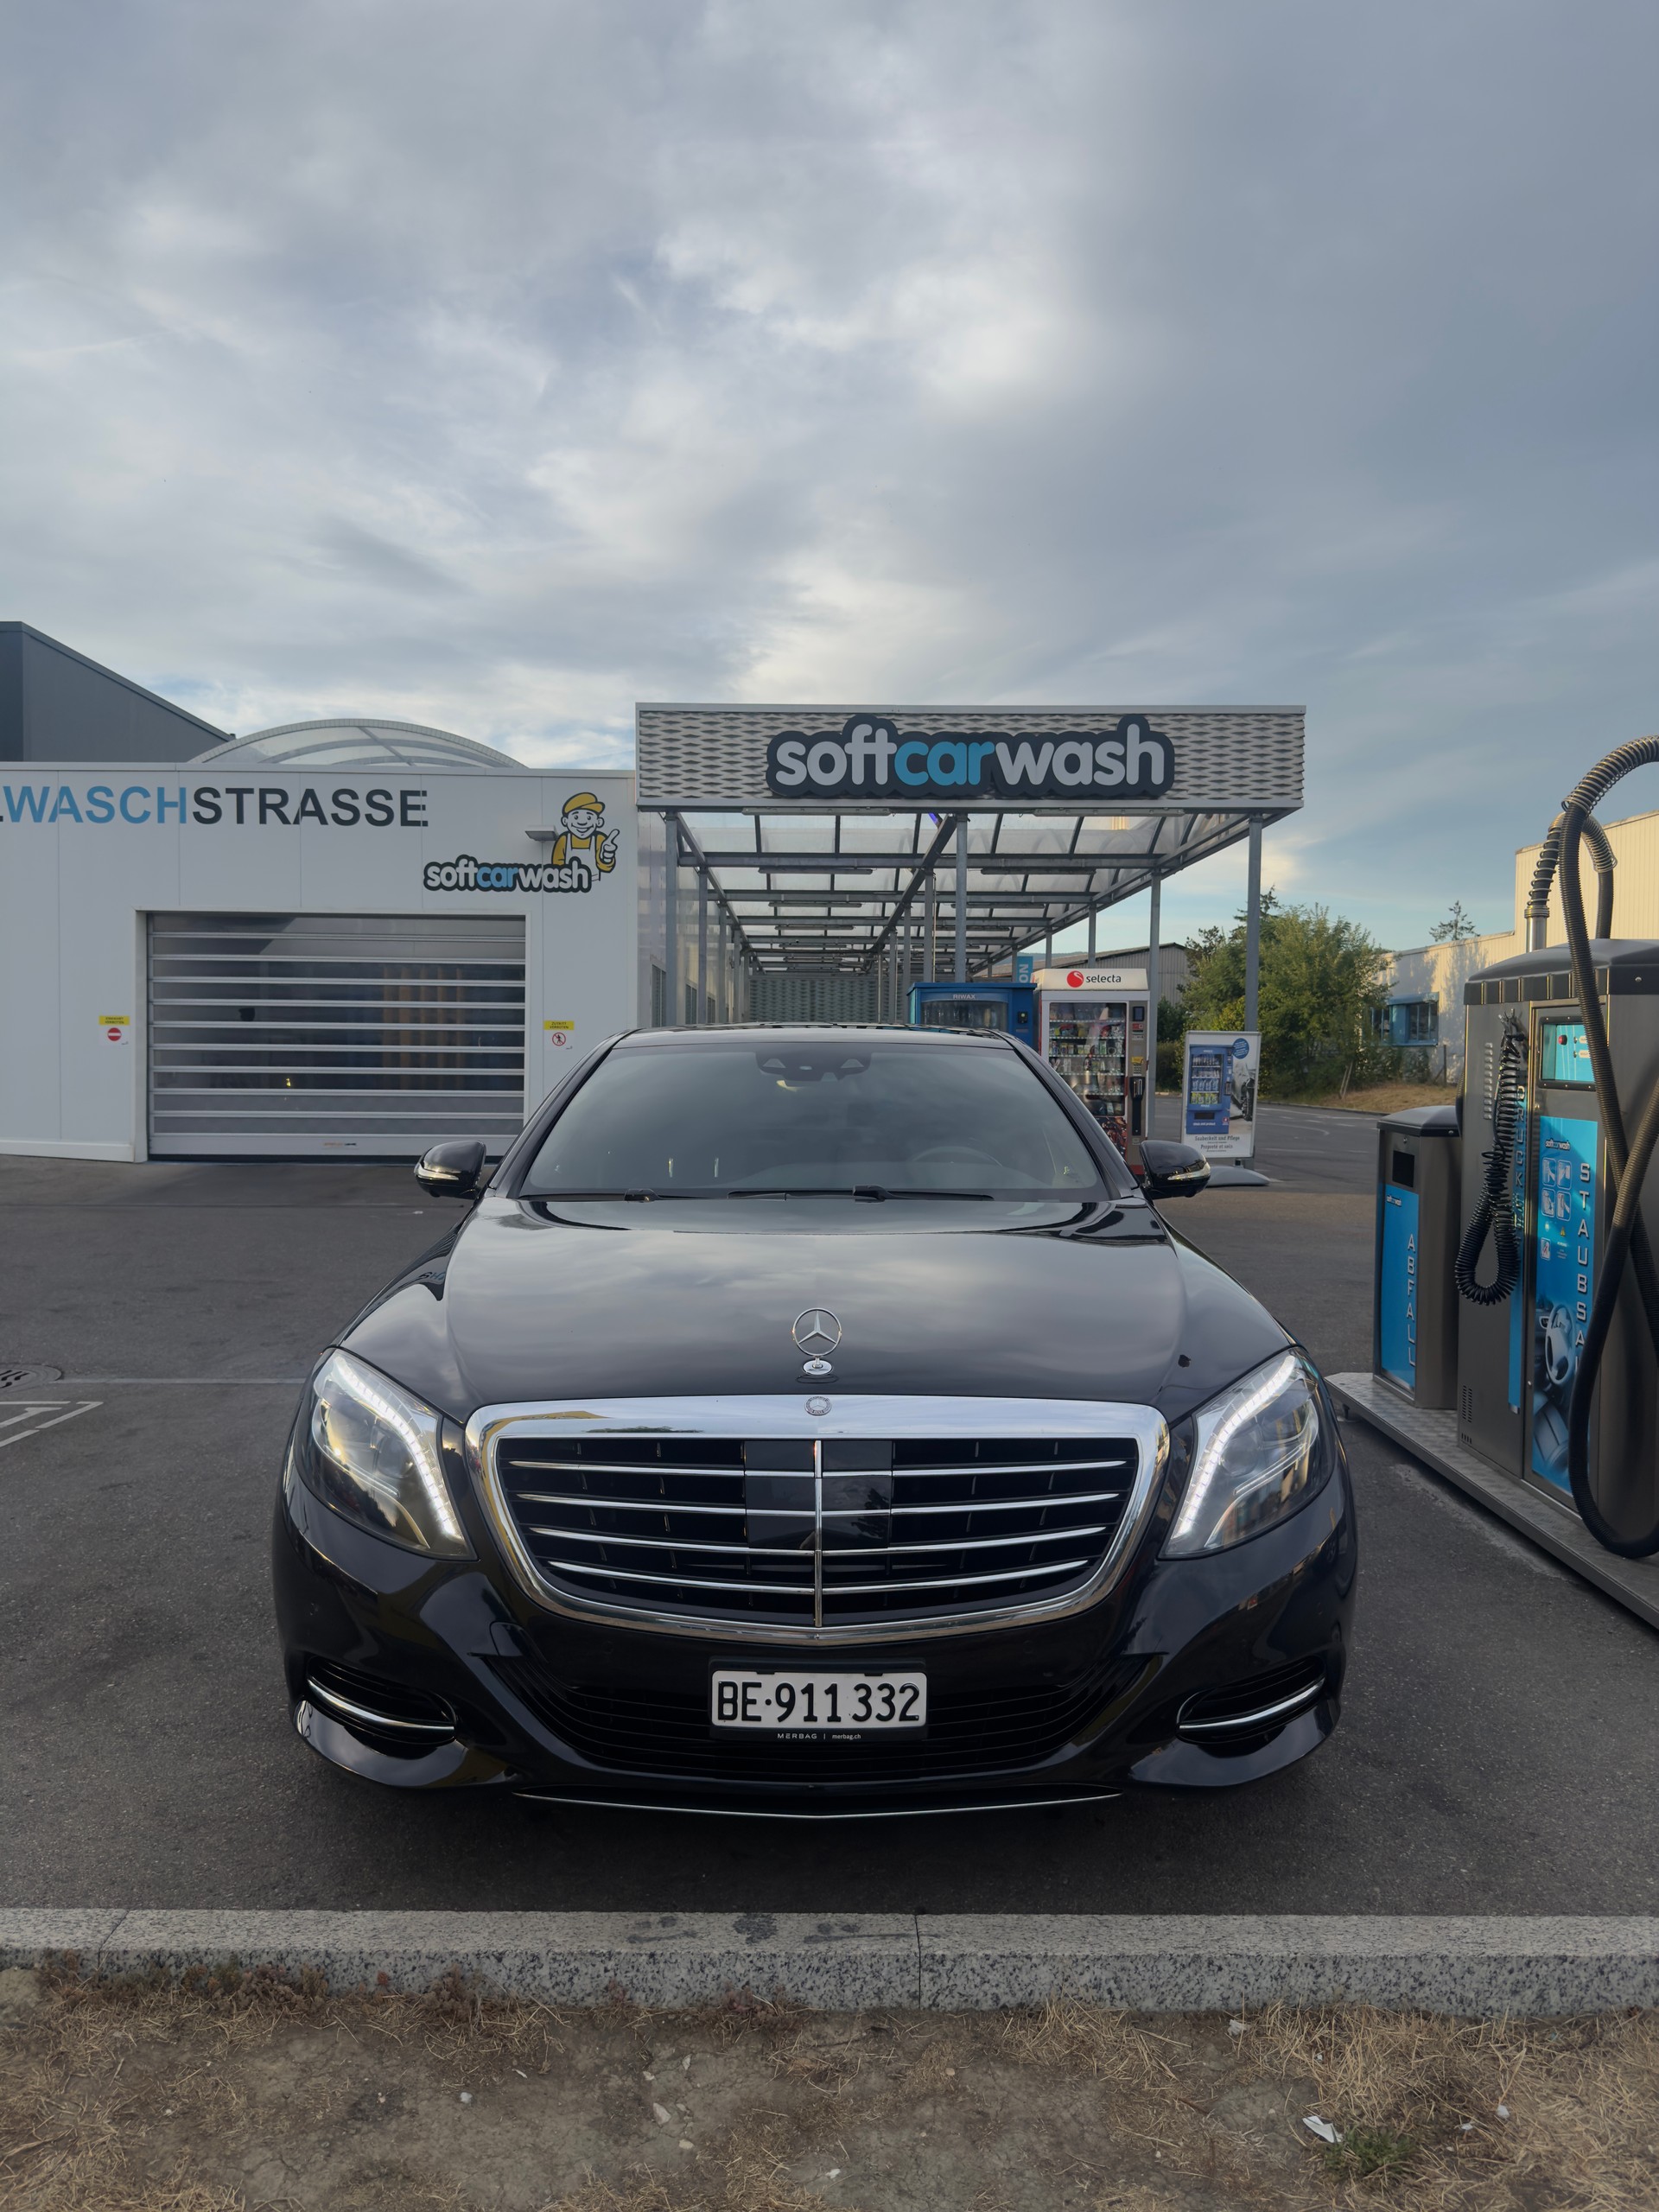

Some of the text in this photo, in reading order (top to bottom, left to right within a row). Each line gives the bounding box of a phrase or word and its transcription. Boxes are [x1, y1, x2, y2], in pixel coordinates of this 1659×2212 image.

[775, 723, 1166, 786] softcarwash
[0, 785, 429, 827] WASCHSTRASSE
[426, 858, 588, 889] softcarwash
[1085, 974, 1122, 983] selecta
[1574, 1163, 1591, 1372] STAUBSA
[1406, 1234, 1416, 1367] ABFALL
